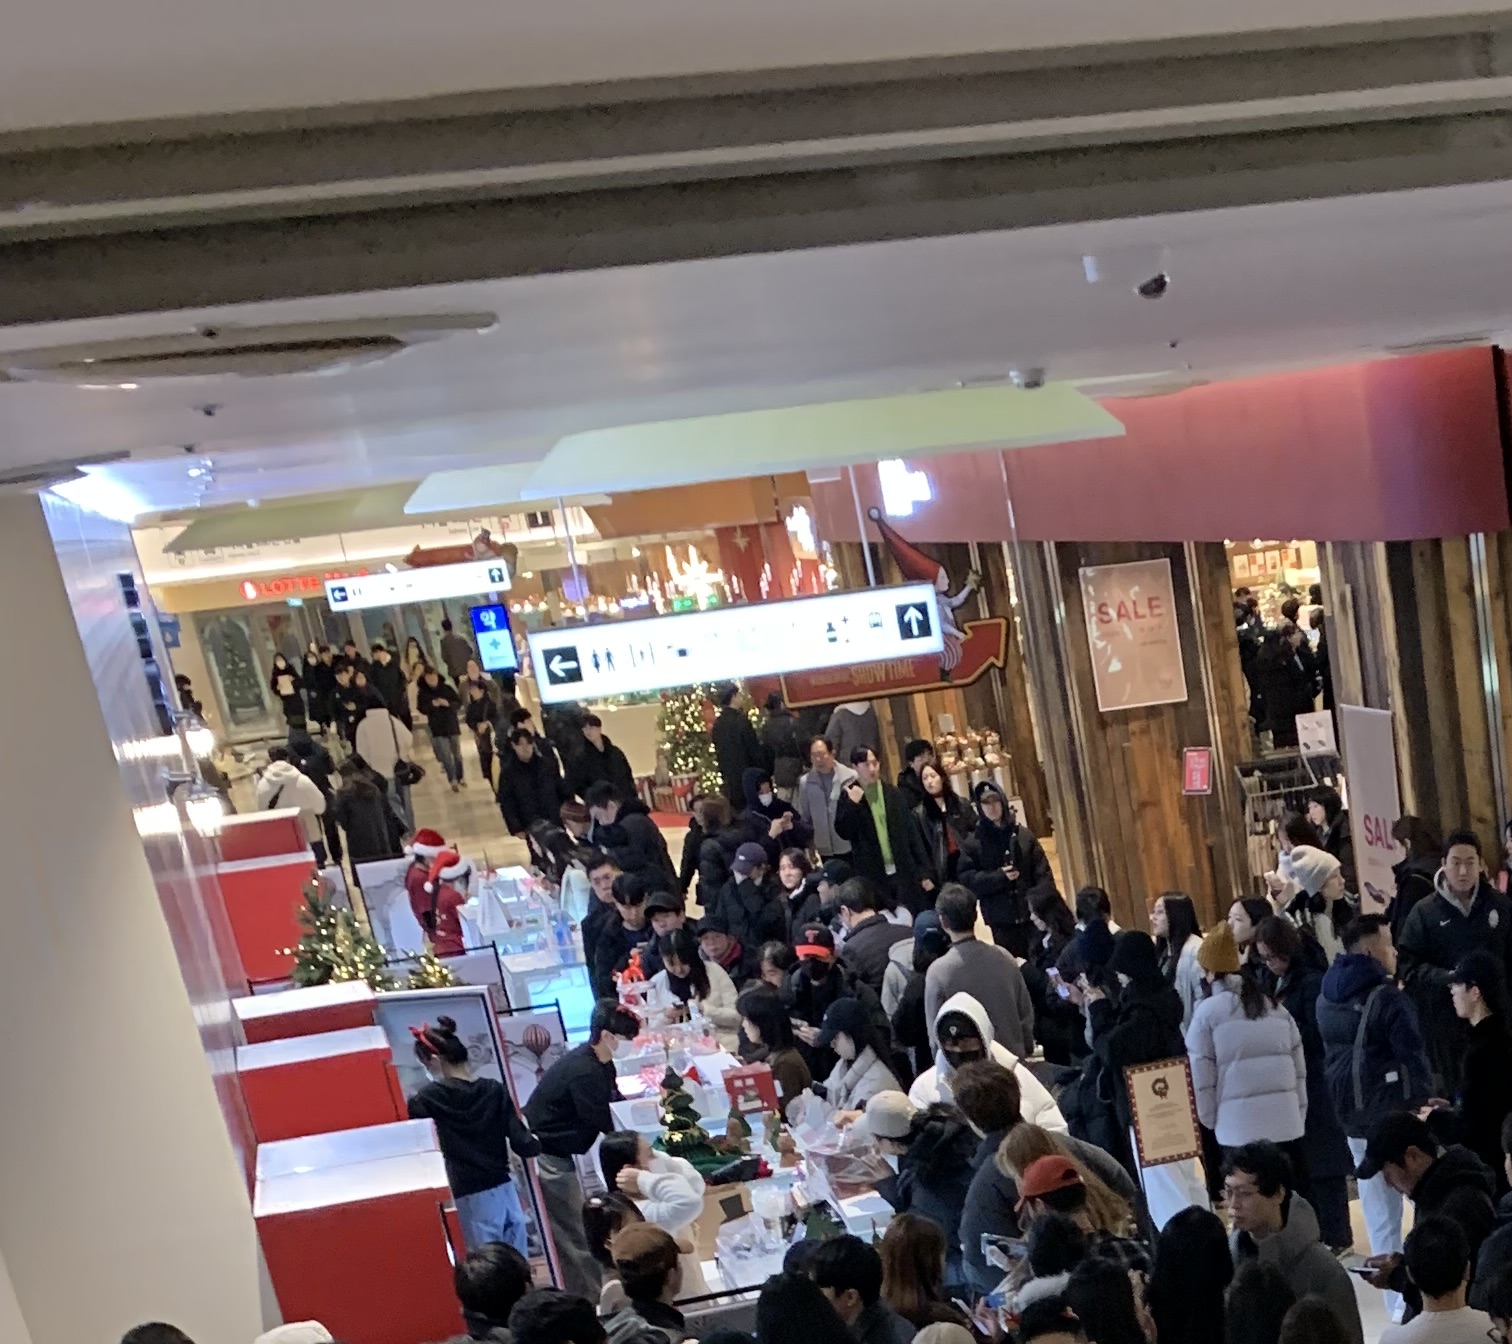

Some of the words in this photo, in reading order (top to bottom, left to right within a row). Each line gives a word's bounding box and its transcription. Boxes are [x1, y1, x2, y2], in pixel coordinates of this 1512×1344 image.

[260, 575, 320, 597] LOTTE
[1097, 596, 1163, 624] SALE
[1363, 814, 1394, 850] SAL
